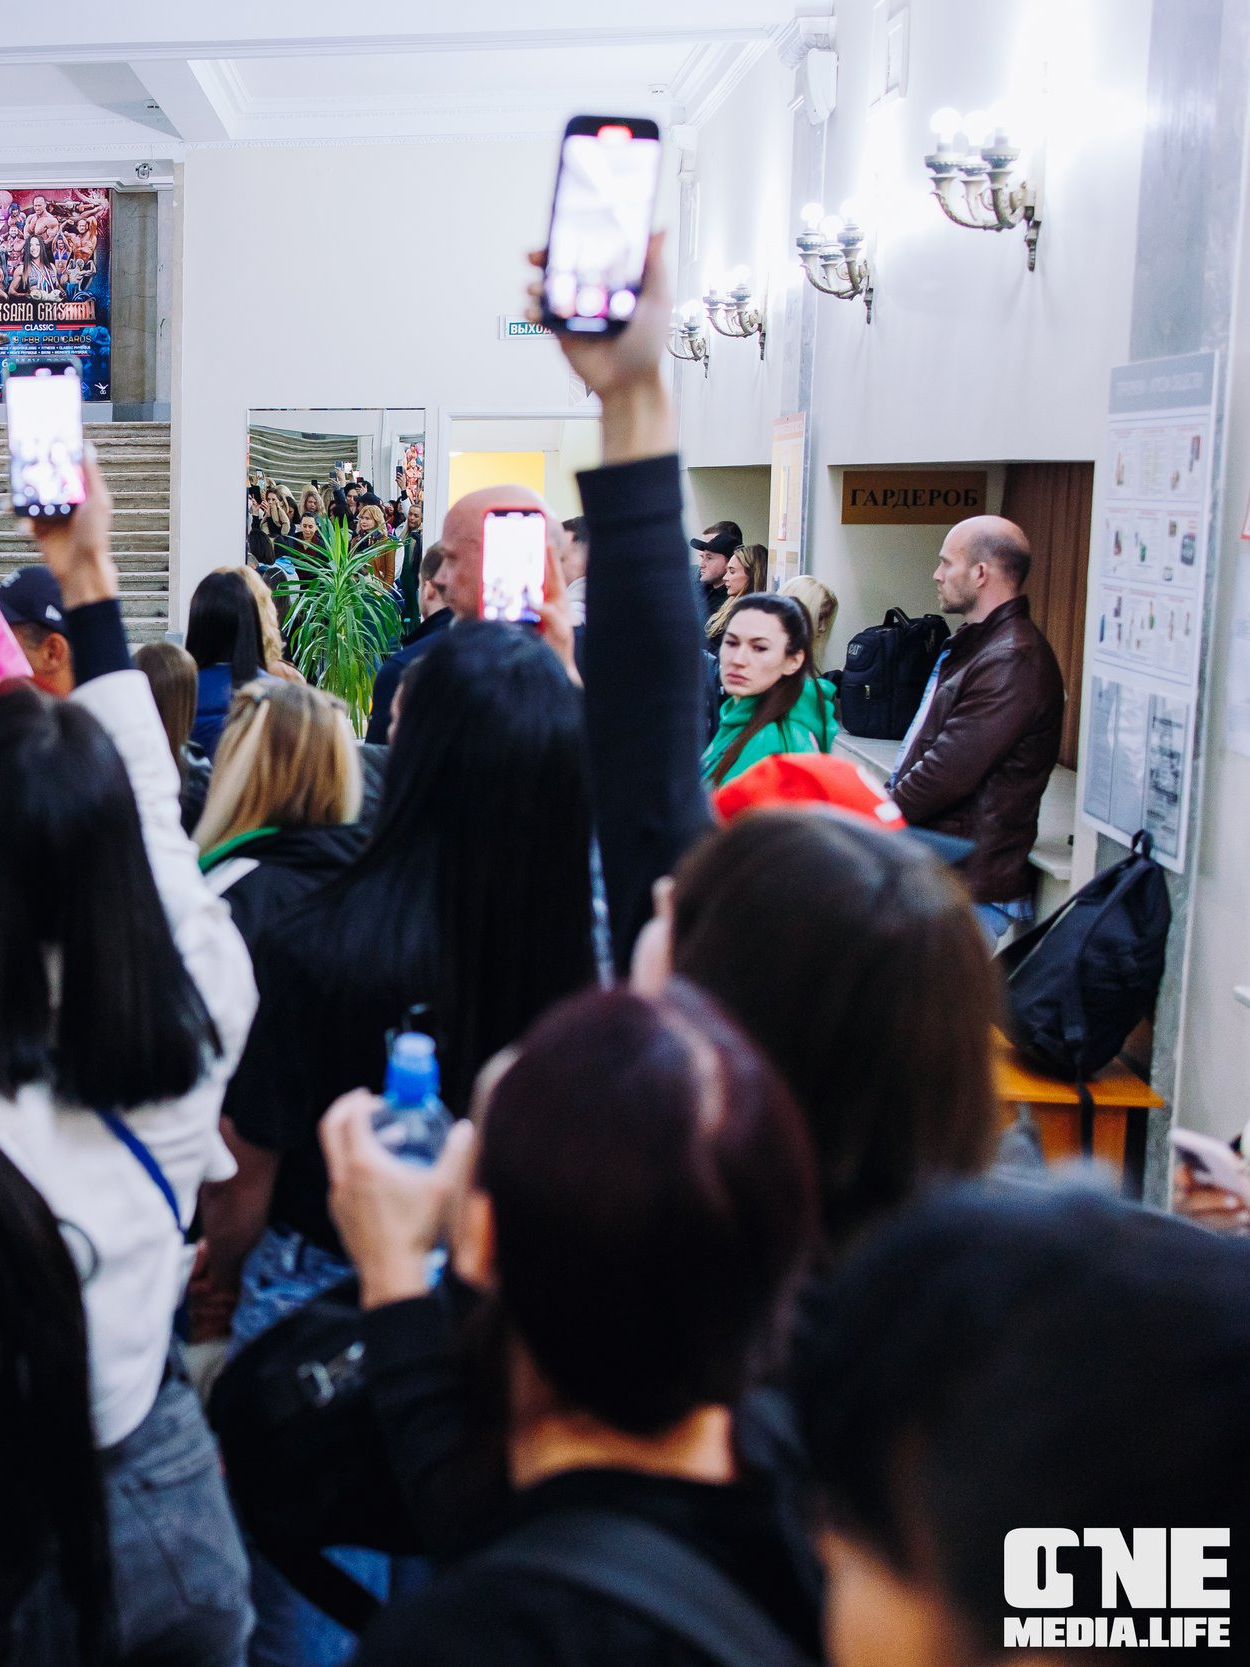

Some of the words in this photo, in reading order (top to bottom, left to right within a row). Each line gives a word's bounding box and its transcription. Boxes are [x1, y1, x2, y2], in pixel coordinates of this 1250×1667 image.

[42, 335, 60, 344] PRO
[61, 335, 91, 344] CARDS
[851, 489, 978, 508] ГАРДЕРОБ
